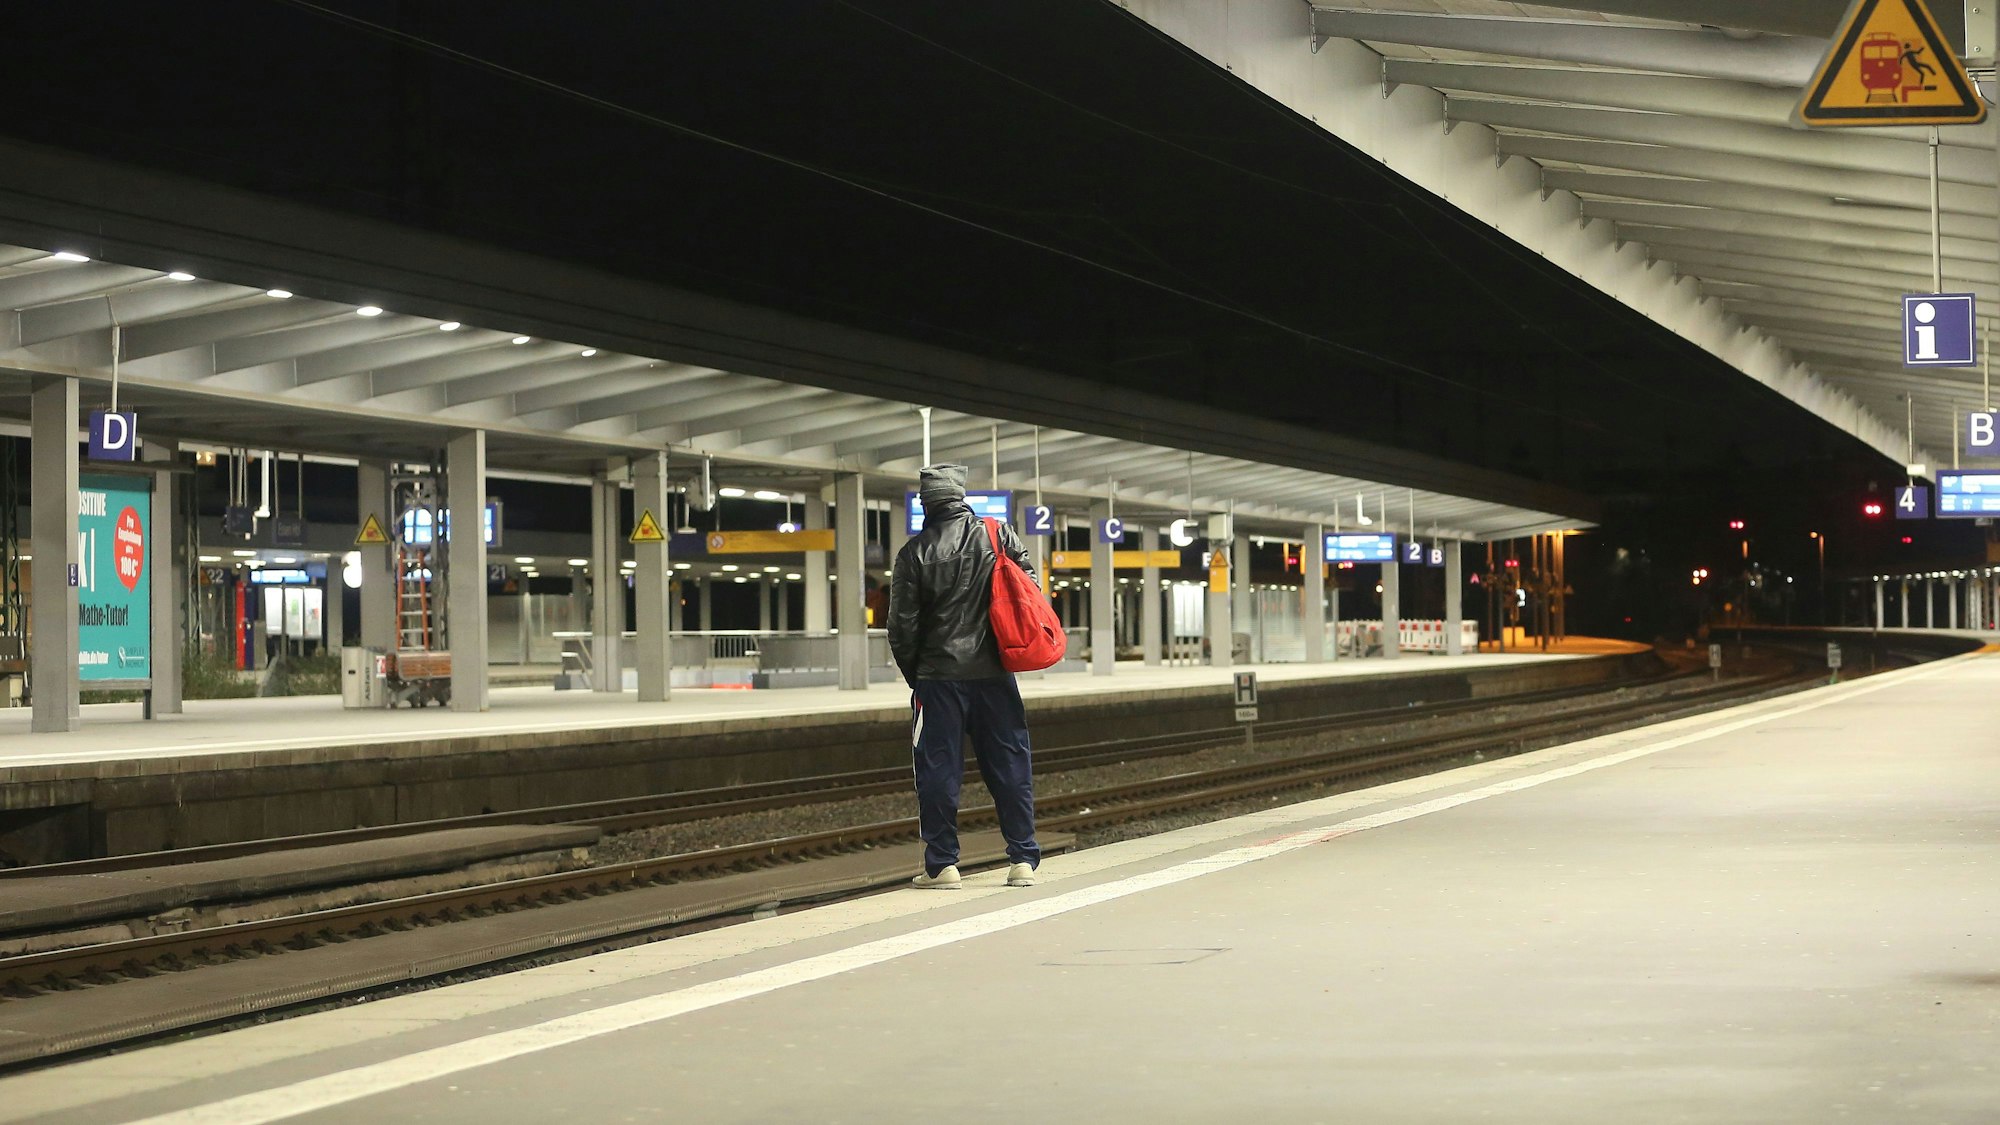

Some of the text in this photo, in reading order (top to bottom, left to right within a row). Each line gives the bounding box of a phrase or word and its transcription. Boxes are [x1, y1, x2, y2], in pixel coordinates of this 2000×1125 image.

[102, 413, 128, 450] D
[1970, 412, 1995, 447] B
[1899, 487, 1916, 512] 4
[1035, 506, 1051, 530] 2
[1105, 518, 1121, 539] C
[1409, 543, 1421, 560] 2
[1431, 549, 1442, 564] B
[491, 565, 506, 580] 21
[79, 603, 129, 626] Mathe-Tutor!
[1237, 675, 1254, 702] H
